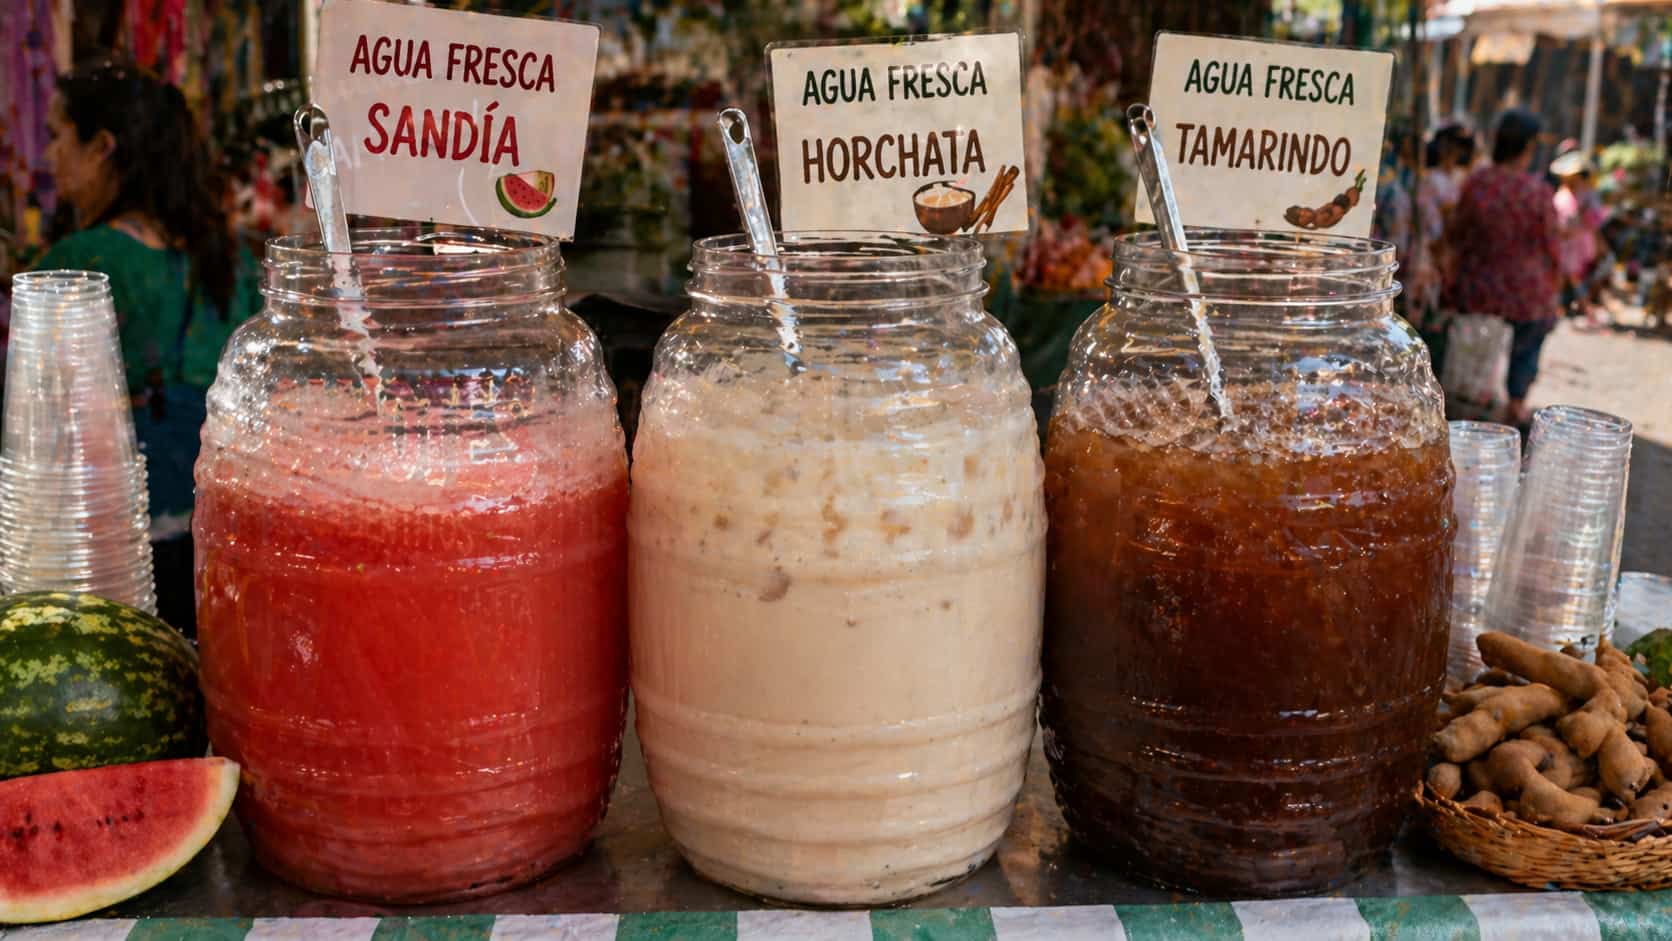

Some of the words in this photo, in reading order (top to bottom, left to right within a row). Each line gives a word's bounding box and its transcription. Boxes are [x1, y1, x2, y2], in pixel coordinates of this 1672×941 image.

[350, 34, 432, 79] AGUA
[446, 43, 555, 93] FRESCA
[802, 67, 876, 106] AGUA
[888, 61, 987, 100] FRESCA
[1184, 59, 1253, 96] AGUA
[1265, 65, 1354, 106] FRESCA
[364, 101, 519, 167] SANDÍA
[802, 129, 986, 184] HORCHATA
[1176, 123, 1351, 177] TAMARINDO
